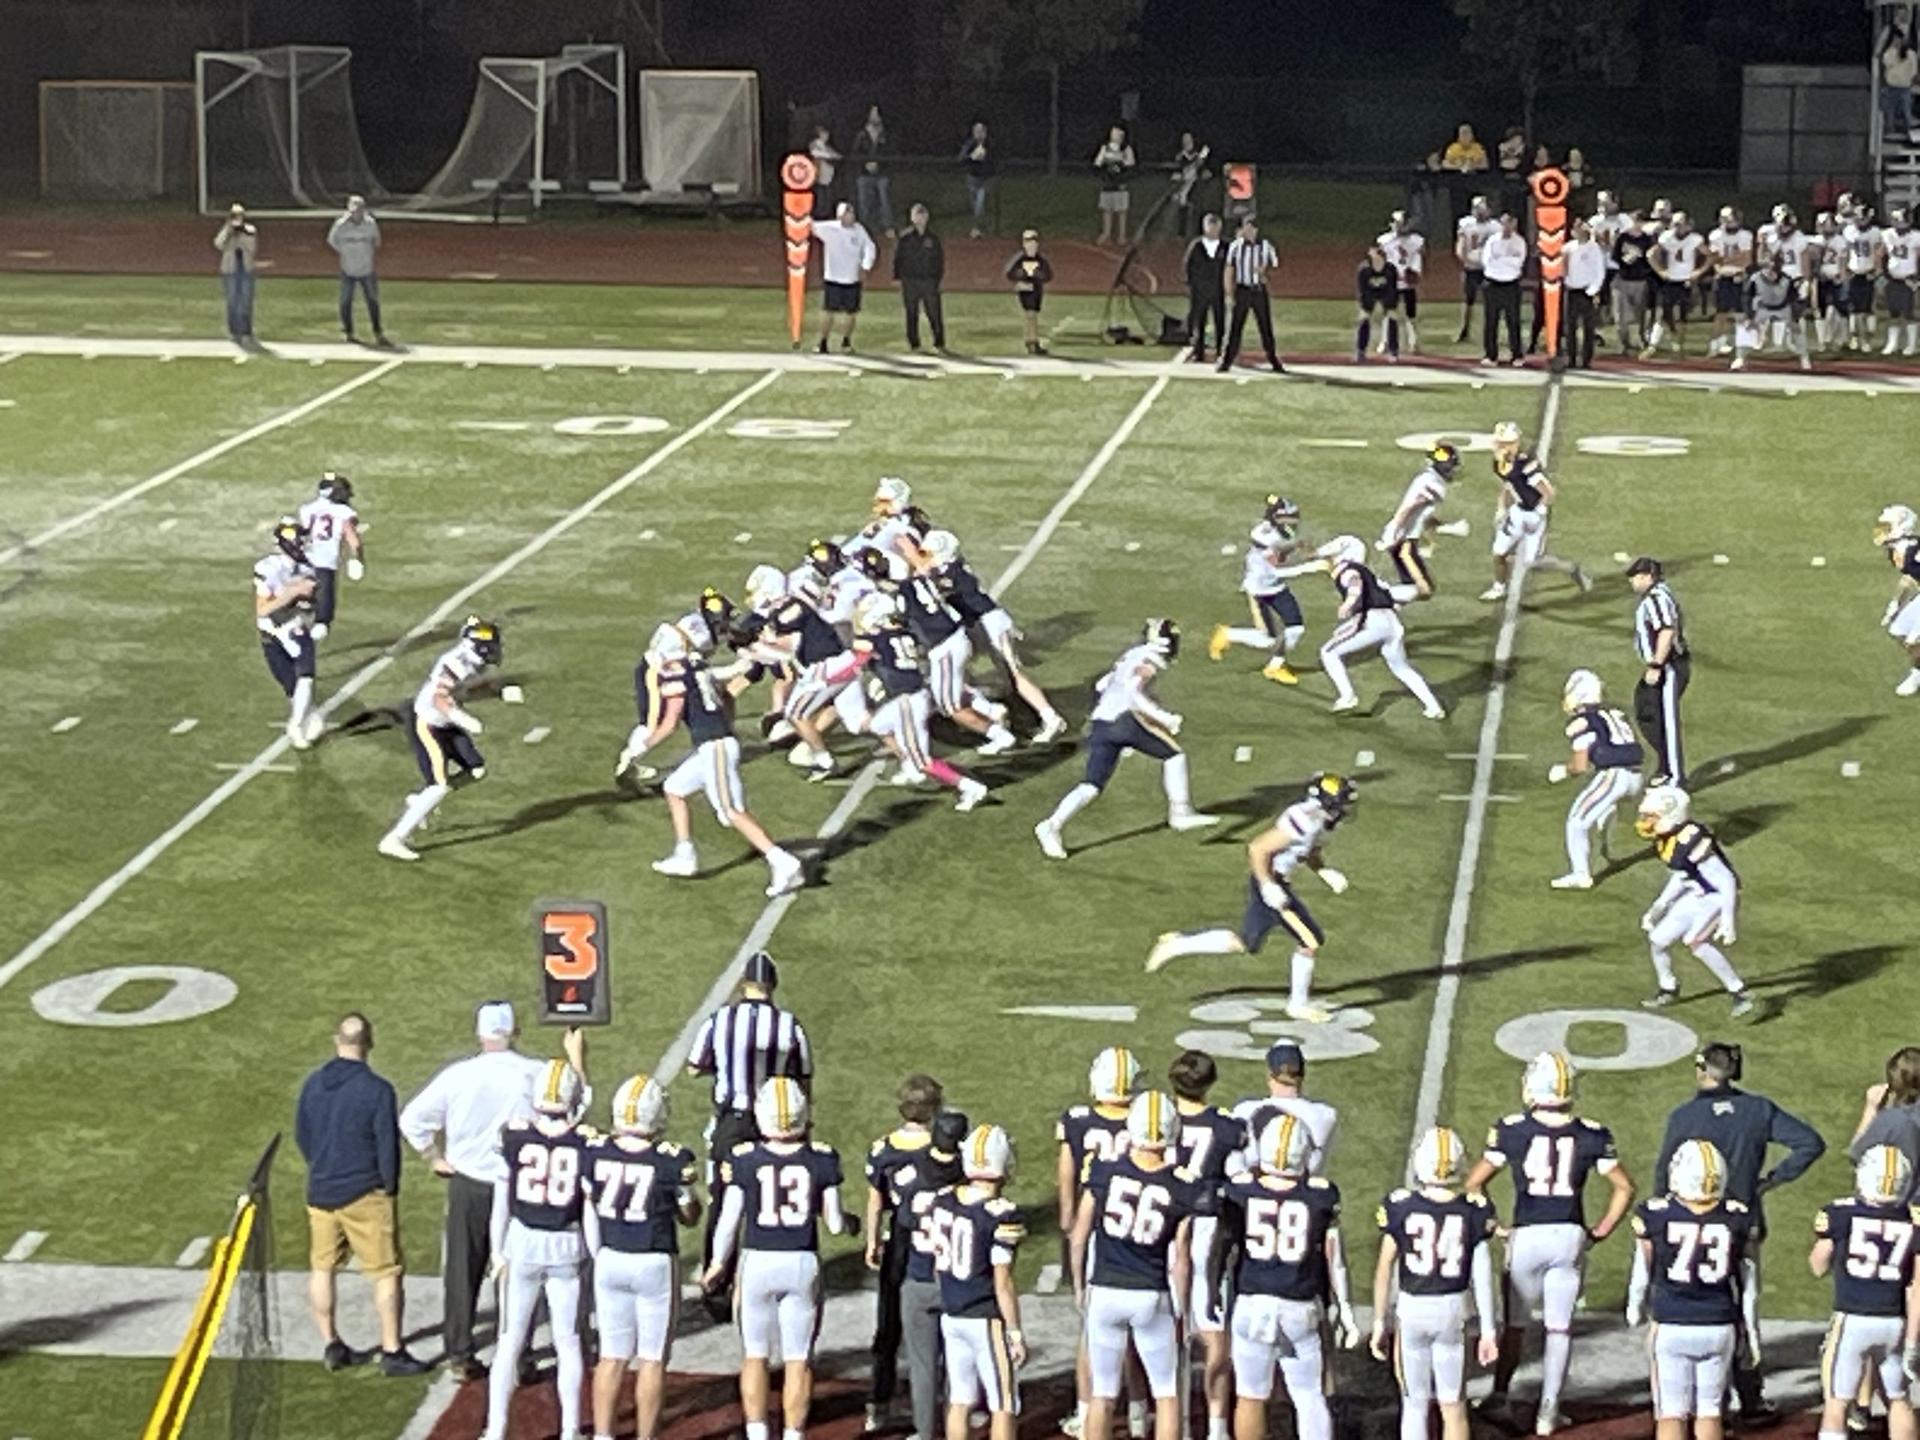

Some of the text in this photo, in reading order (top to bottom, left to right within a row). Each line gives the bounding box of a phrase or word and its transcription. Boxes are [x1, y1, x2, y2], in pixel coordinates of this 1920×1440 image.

[544, 912, 597, 981] 3
[30, 964, 239, 1026] 0
[516, 1143, 580, 1208] 28
[592, 1159, 655, 1223] 77
[755, 1165, 812, 1228] 13
[1523, 1136, 1575, 1197] 41
[1103, 1174, 1172, 1246] 56
[1245, 1197, 1310, 1264] 58
[1404, 1212, 1465, 1279] 34
[1666, 1222, 1732, 1284] 73
[1846, 1217, 1915, 1282] 57
